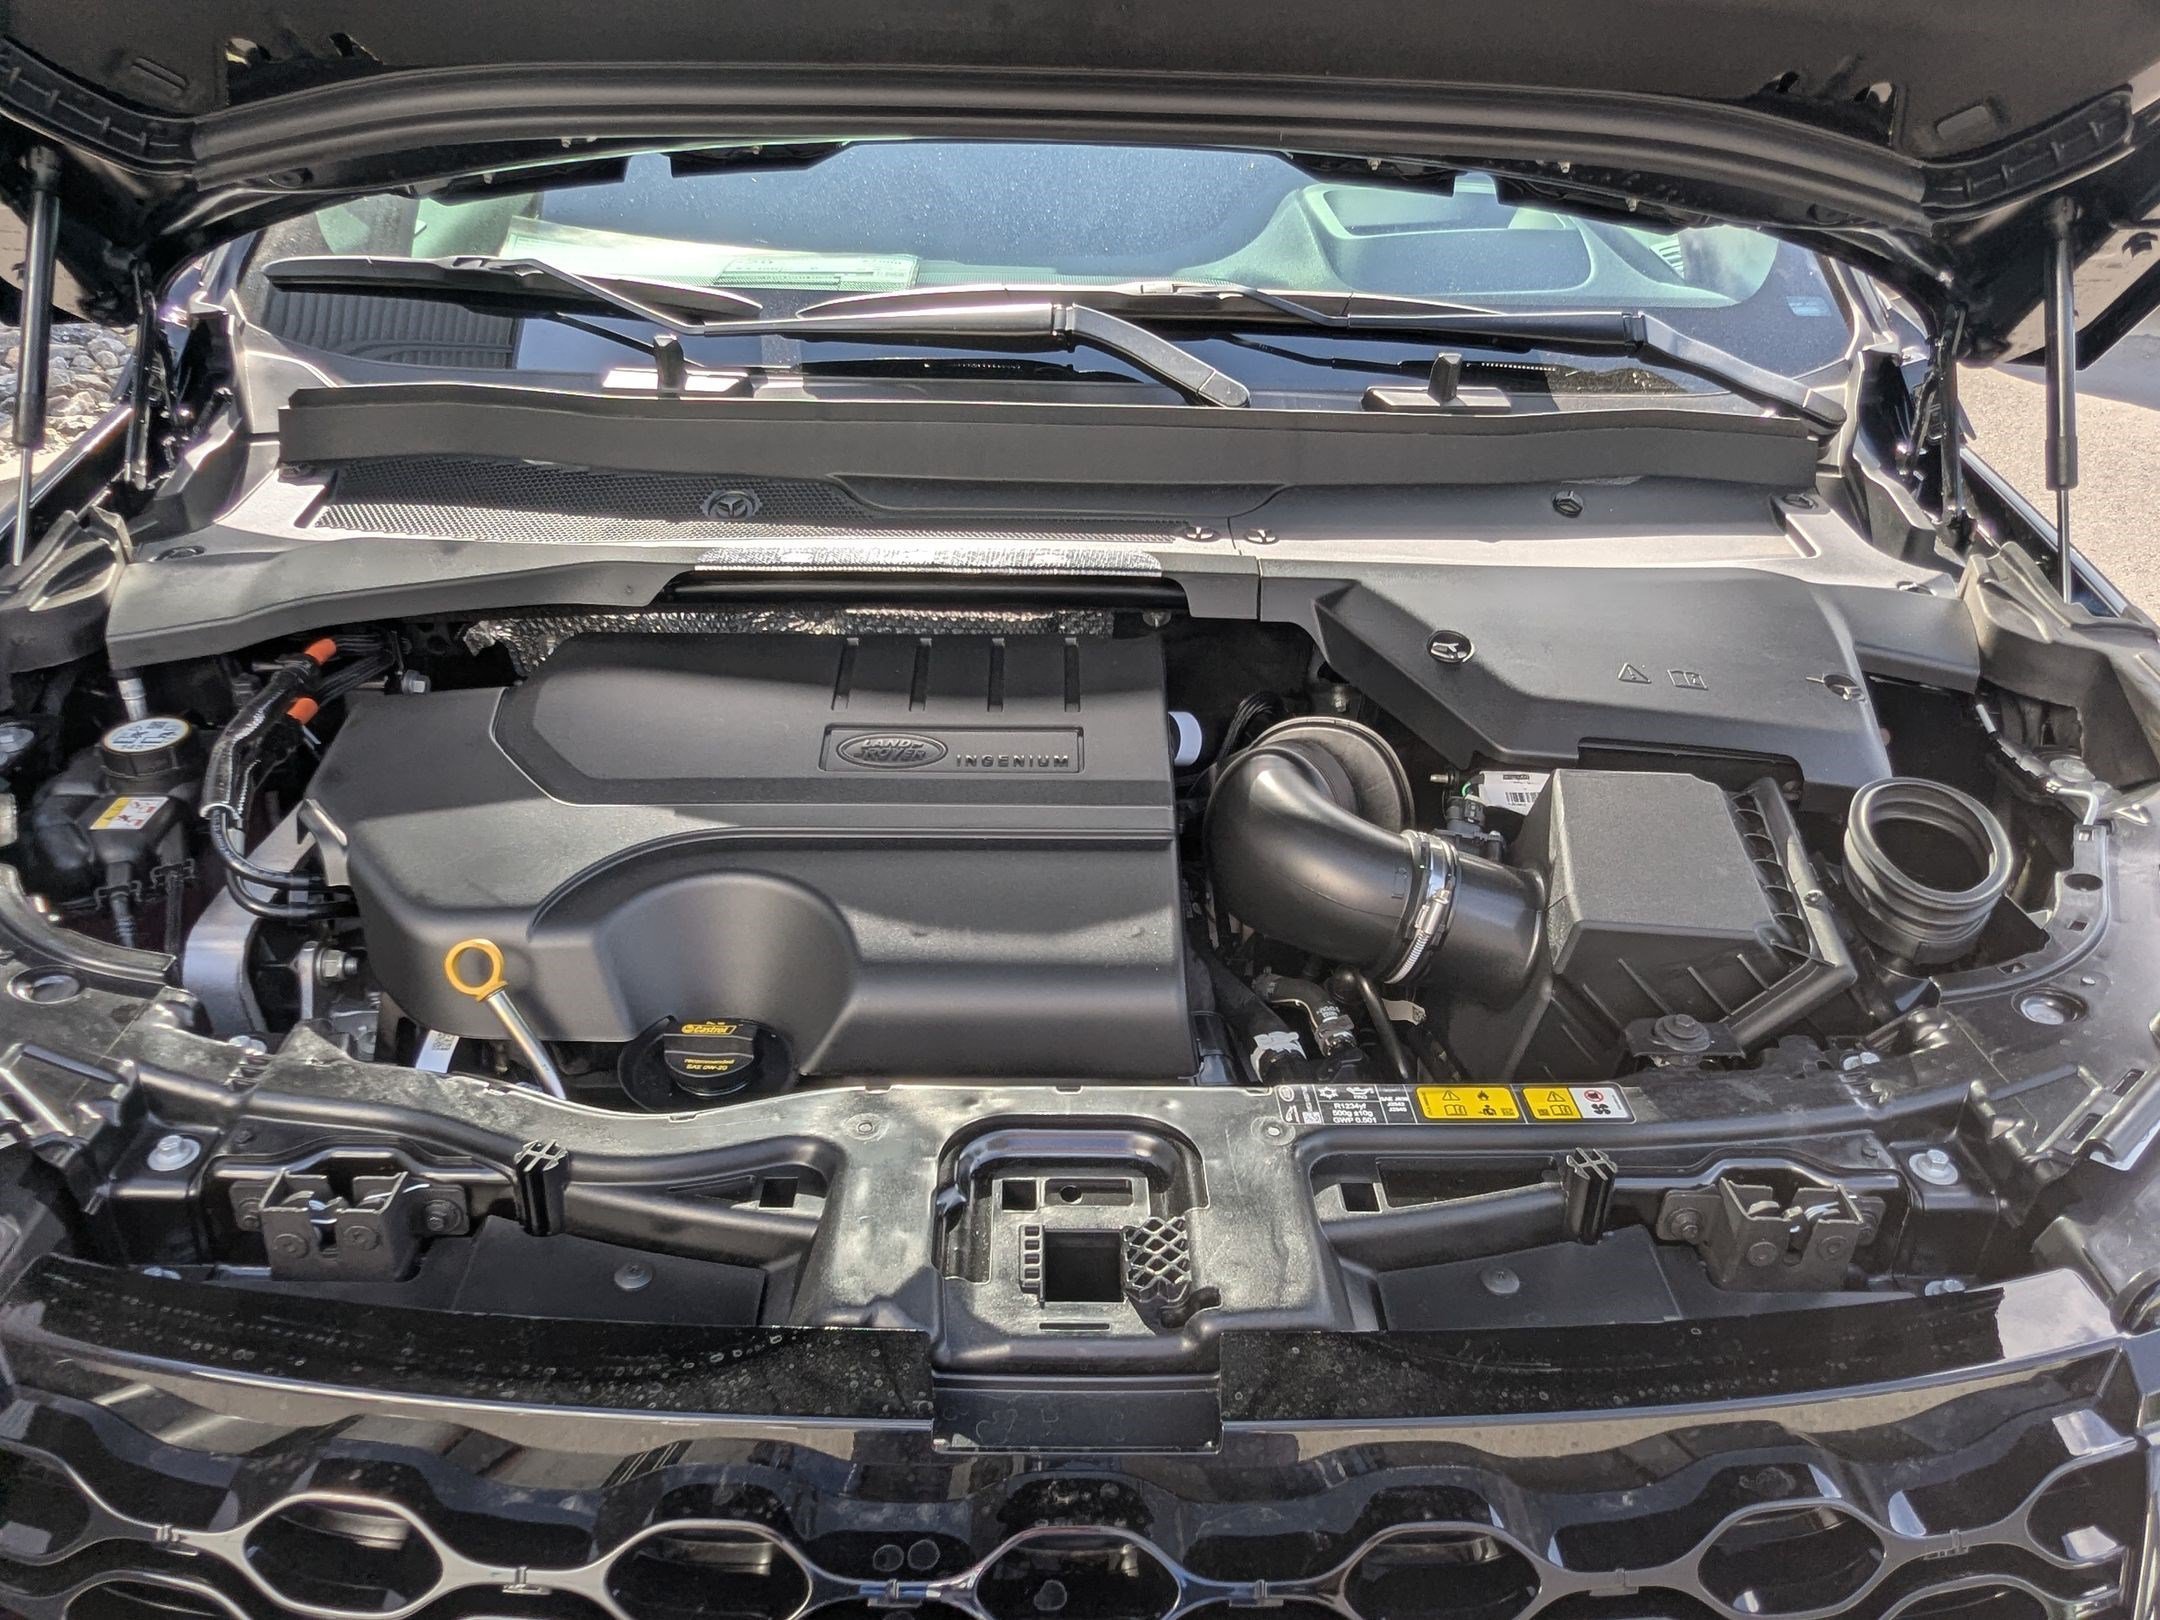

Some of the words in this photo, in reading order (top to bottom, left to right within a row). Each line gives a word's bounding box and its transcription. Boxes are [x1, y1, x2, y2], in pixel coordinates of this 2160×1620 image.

[862, 738, 913, 748] LAND
[861, 747, 927, 761] ROVER
[956, 754, 1070, 768] INGENIUM
[693, 1024, 729, 1034] Castrol
[1333, 1102, 1367, 1111] R1234yf
[1332, 1109, 1353, 1118] 500g
[1332, 1116, 1354, 1124] GWP
